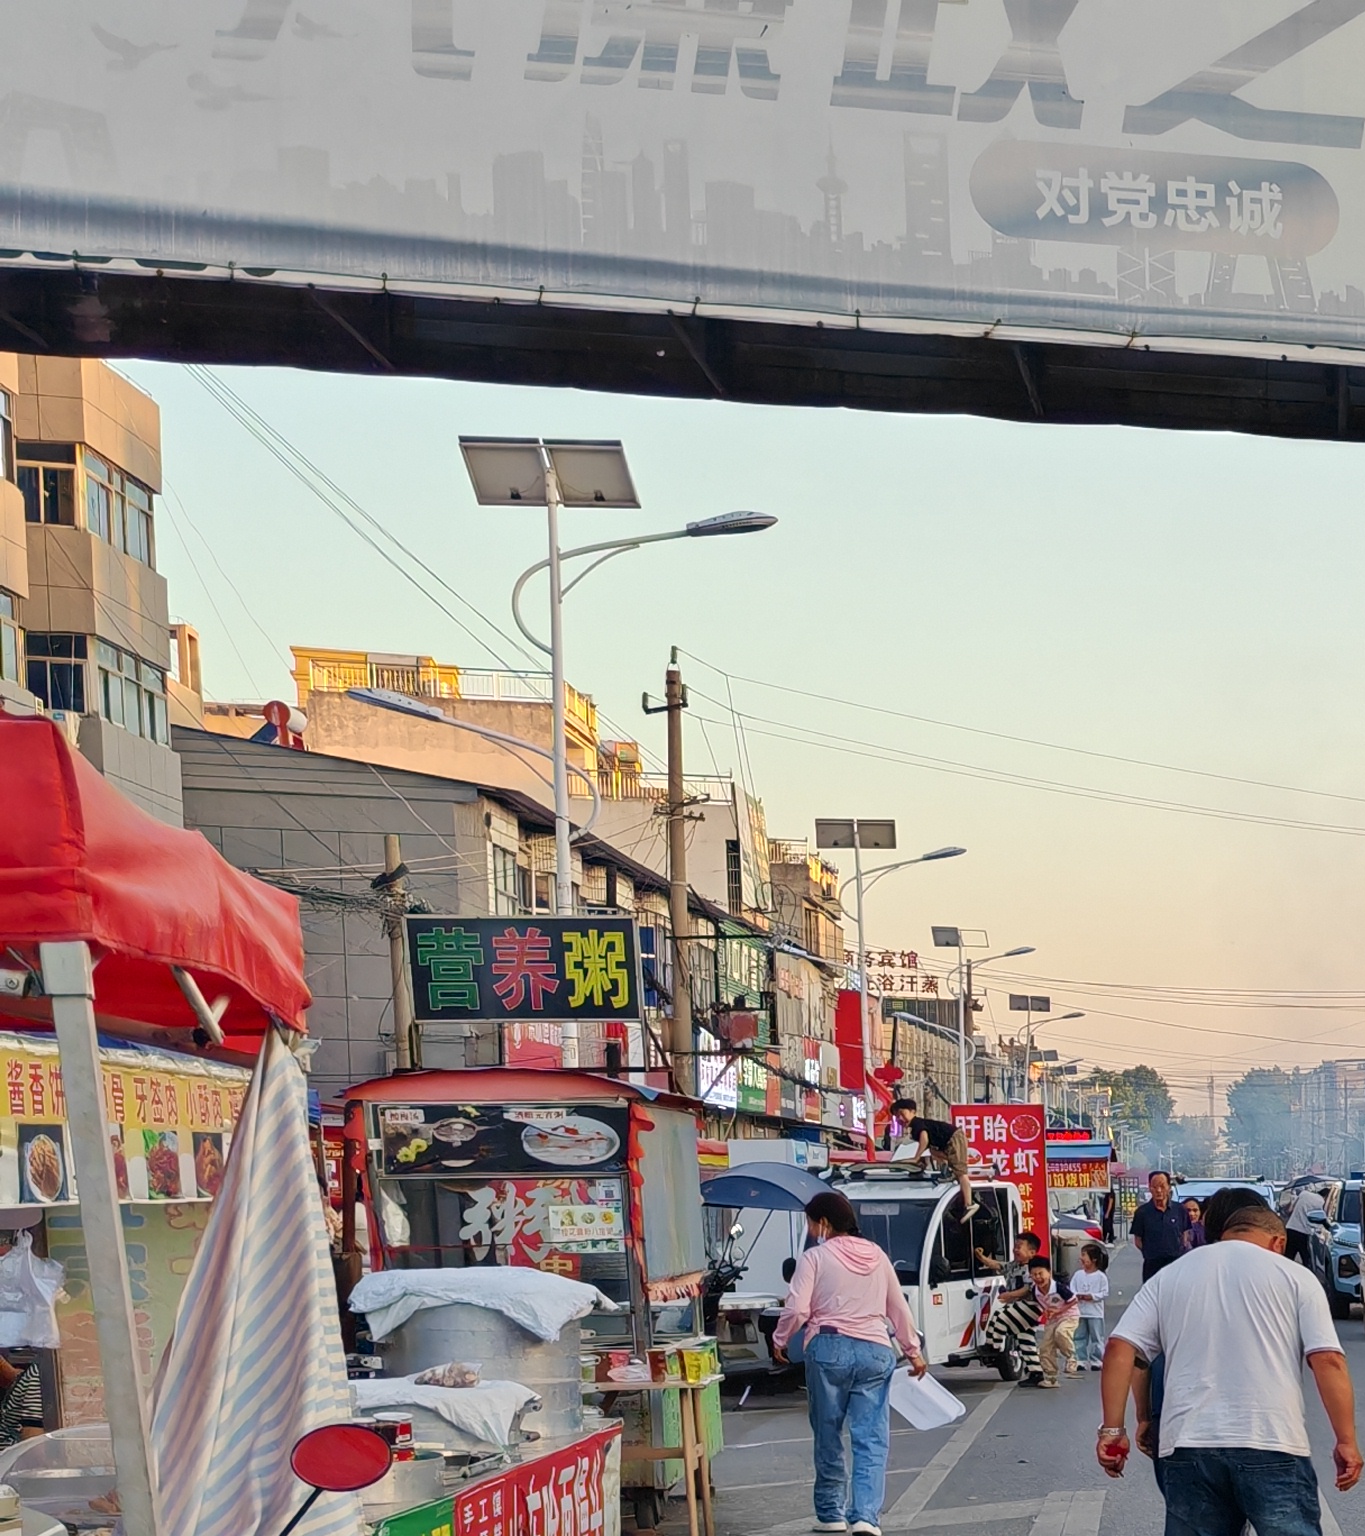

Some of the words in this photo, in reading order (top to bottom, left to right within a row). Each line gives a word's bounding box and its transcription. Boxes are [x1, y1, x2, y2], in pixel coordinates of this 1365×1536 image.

[1034, 165, 1284, 241] 对党忠诚
[416, 926, 629, 1012] 营养粥
[986, 1147, 1040, 1177] 龙虾
